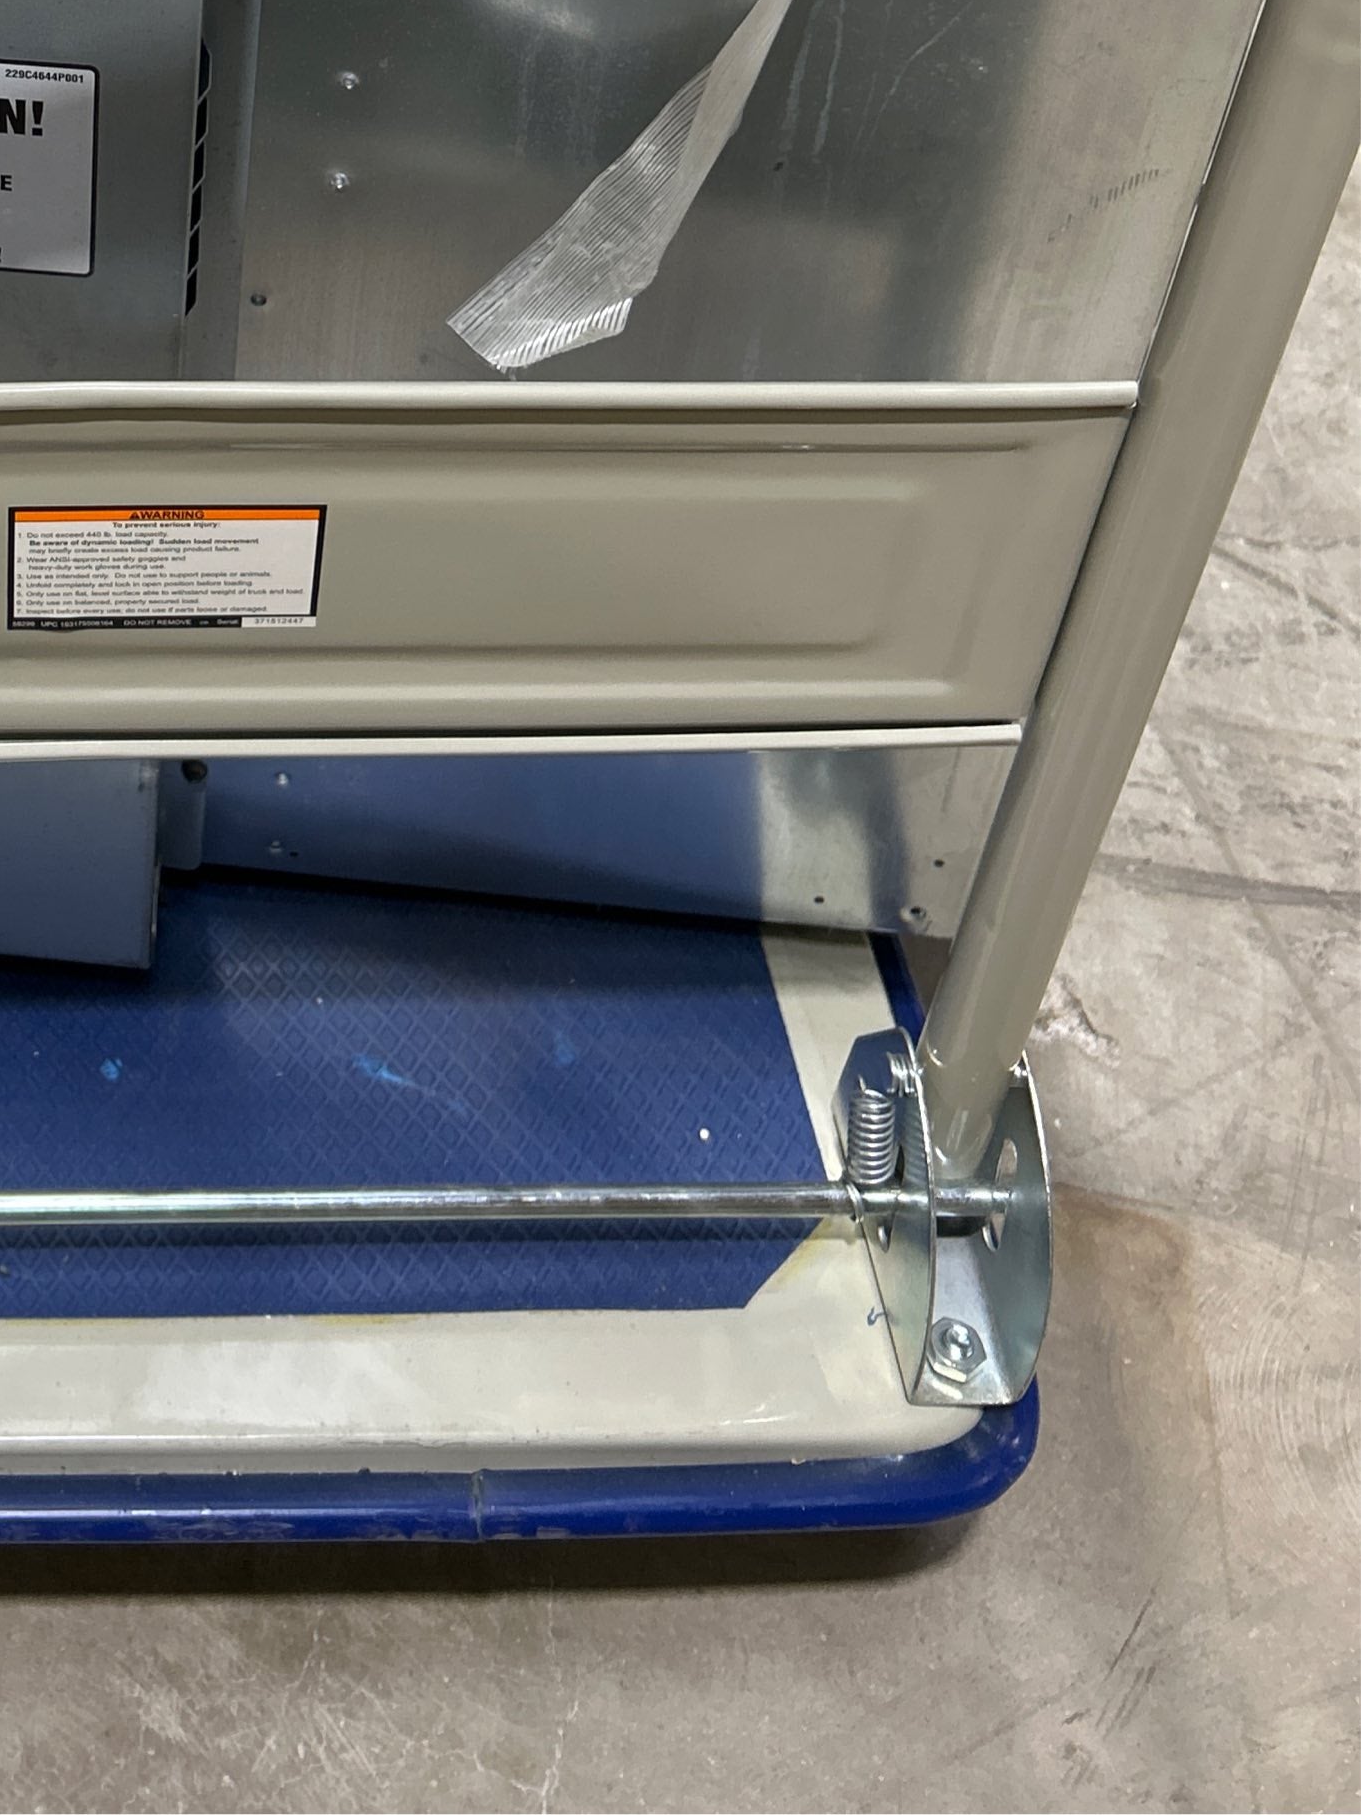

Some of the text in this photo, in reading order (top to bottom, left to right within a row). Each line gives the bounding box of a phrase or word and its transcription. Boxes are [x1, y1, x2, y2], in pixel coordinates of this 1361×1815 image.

[140, 511, 205, 520] WARNING
[124, 521, 157, 529] prevent
[193, 521, 221, 529] injury:
